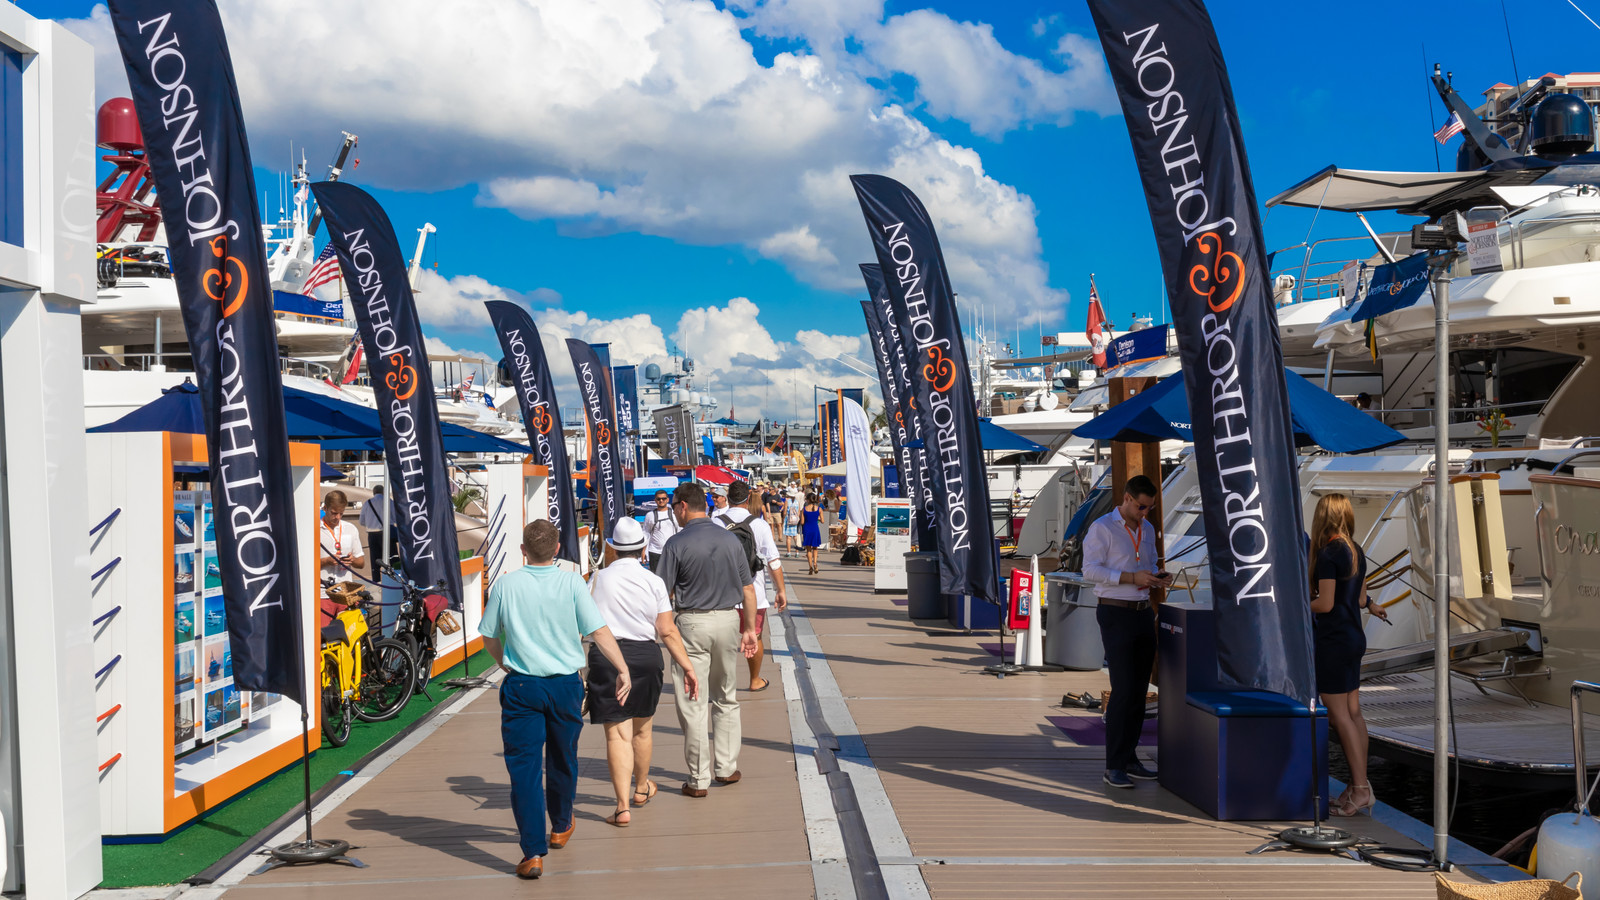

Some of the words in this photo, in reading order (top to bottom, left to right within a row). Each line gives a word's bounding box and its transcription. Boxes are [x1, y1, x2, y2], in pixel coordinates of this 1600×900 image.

[138, 13, 240, 247] JOHNSON
[1123, 23, 1237, 247] JOHNSON
[343, 228, 412, 360] JOHNSON
[883, 221, 950, 352] JOHNSON
[506, 329, 549, 410] JOHNSON
[580, 361, 609, 426] JOHNSON
[1170, 421, 1192, 430] NORT
[391, 398, 434, 564] NORTHROP
[597, 444, 615, 521] NORTHROP
[929, 391, 970, 555] NORTHROP
[1201, 312, 1275, 605] NORTHROP
[1555, 524, 1600, 555] Cha
